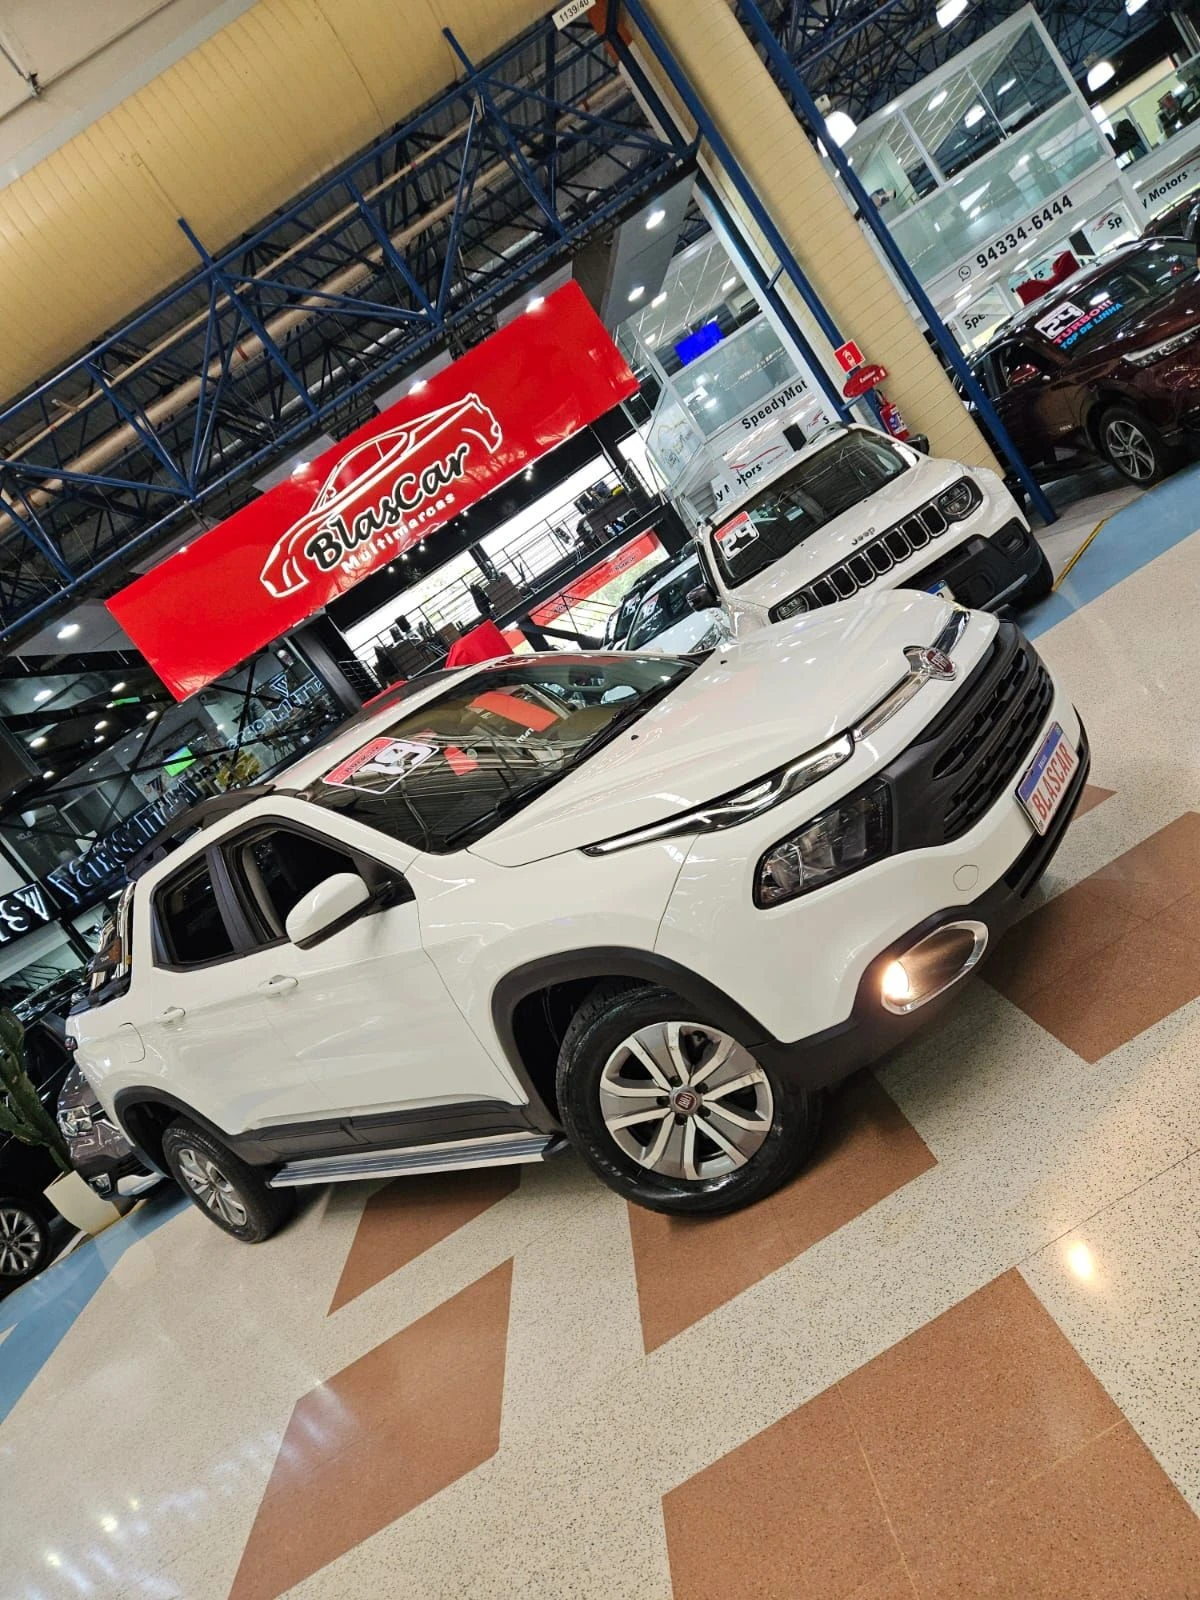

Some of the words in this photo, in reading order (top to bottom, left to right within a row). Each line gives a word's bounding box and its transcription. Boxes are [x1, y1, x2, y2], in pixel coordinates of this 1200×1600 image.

[1148, 171, 1187, 202] Motors
[976, 195, 1073, 269] 94334-6444
[1042, 305, 1082, 337] 24
[1060, 332, 1079, 350] TOP
[1079, 322, 1094, 335] DE
[1093, 302, 1123, 325] LINHA
[303, 443, 470, 572] BlasCar
[340, 492, 456, 574] Multimarcas
[851, 526, 876, 546] Jeep
[1031, 741, 1075, 821] BLASCAR
